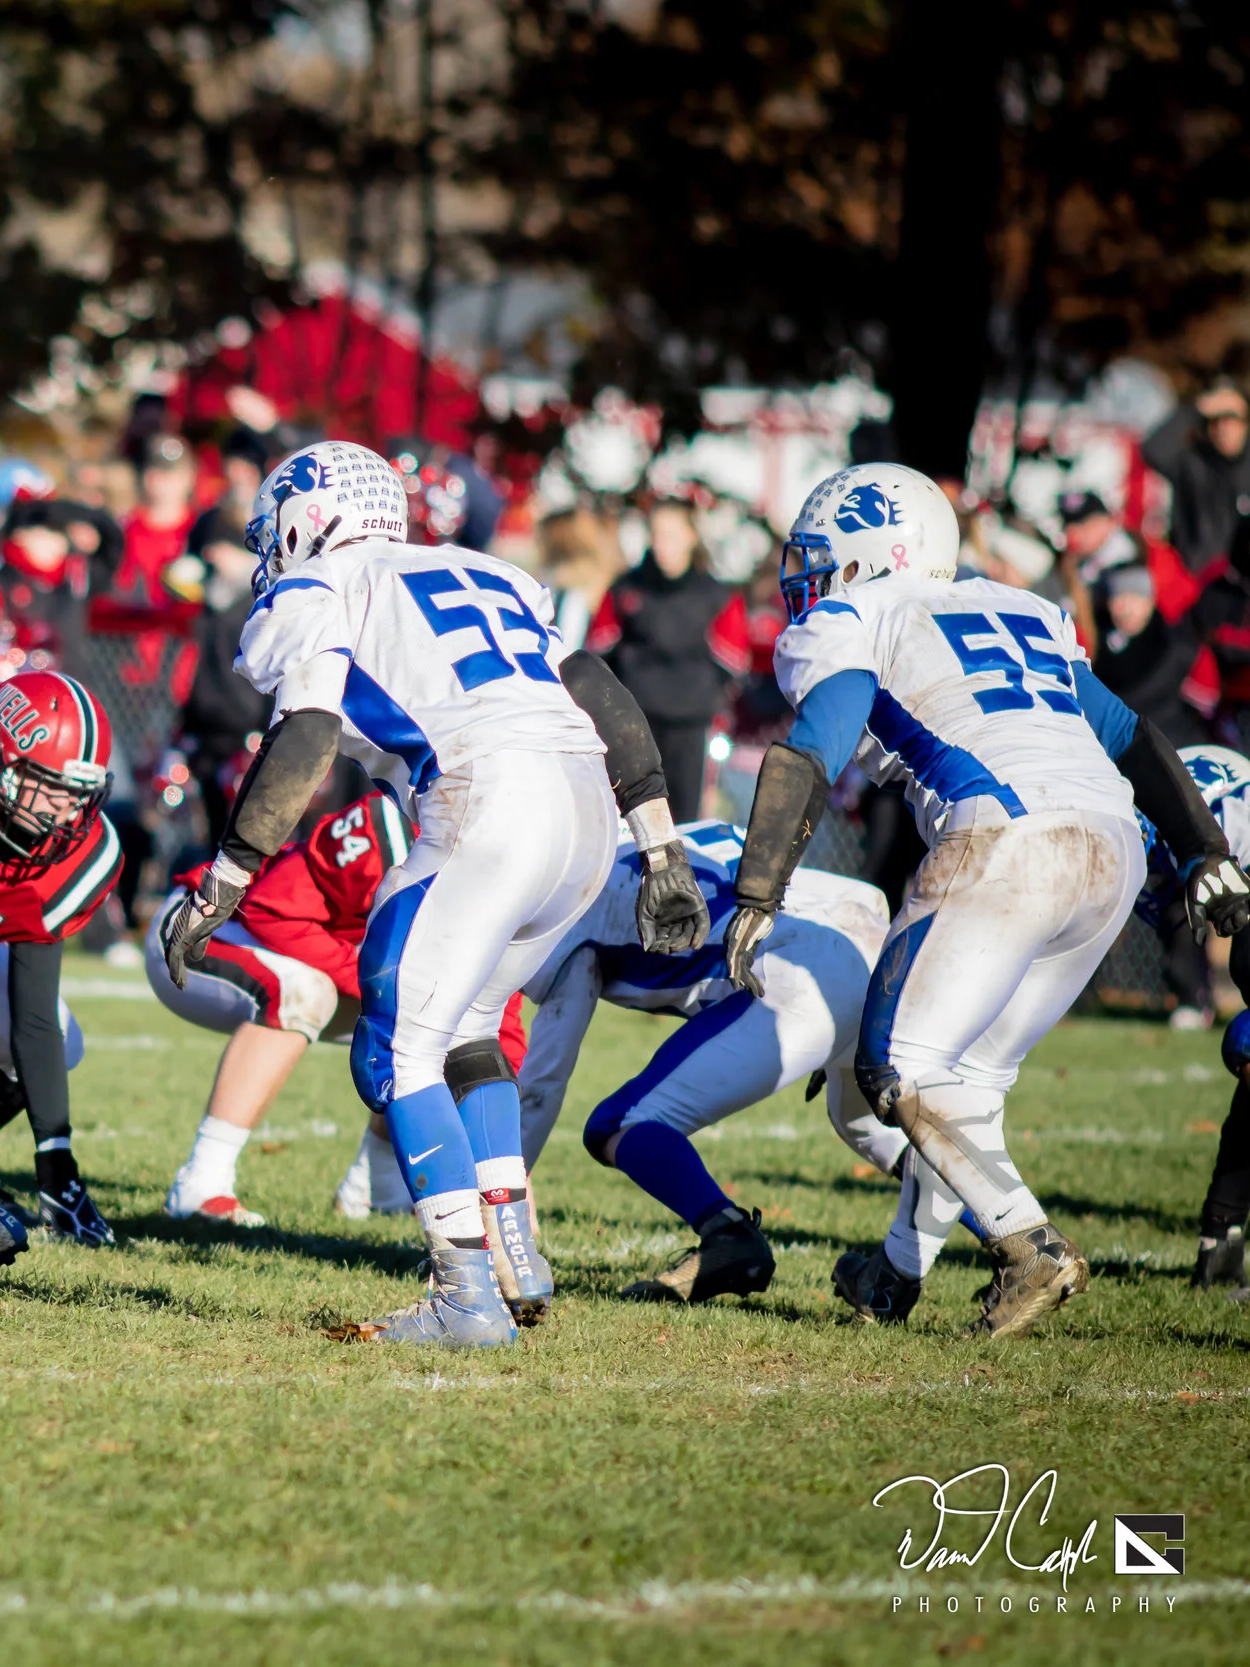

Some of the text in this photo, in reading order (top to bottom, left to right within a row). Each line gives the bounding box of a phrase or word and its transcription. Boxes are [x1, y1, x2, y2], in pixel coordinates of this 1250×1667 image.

[361, 515, 403, 533] schutt
[398, 566, 562, 693] 53
[930, 611, 1083, 717] 55
[331, 806, 371, 868] 54
[500, 1205, 533, 1279] ARMOUR
